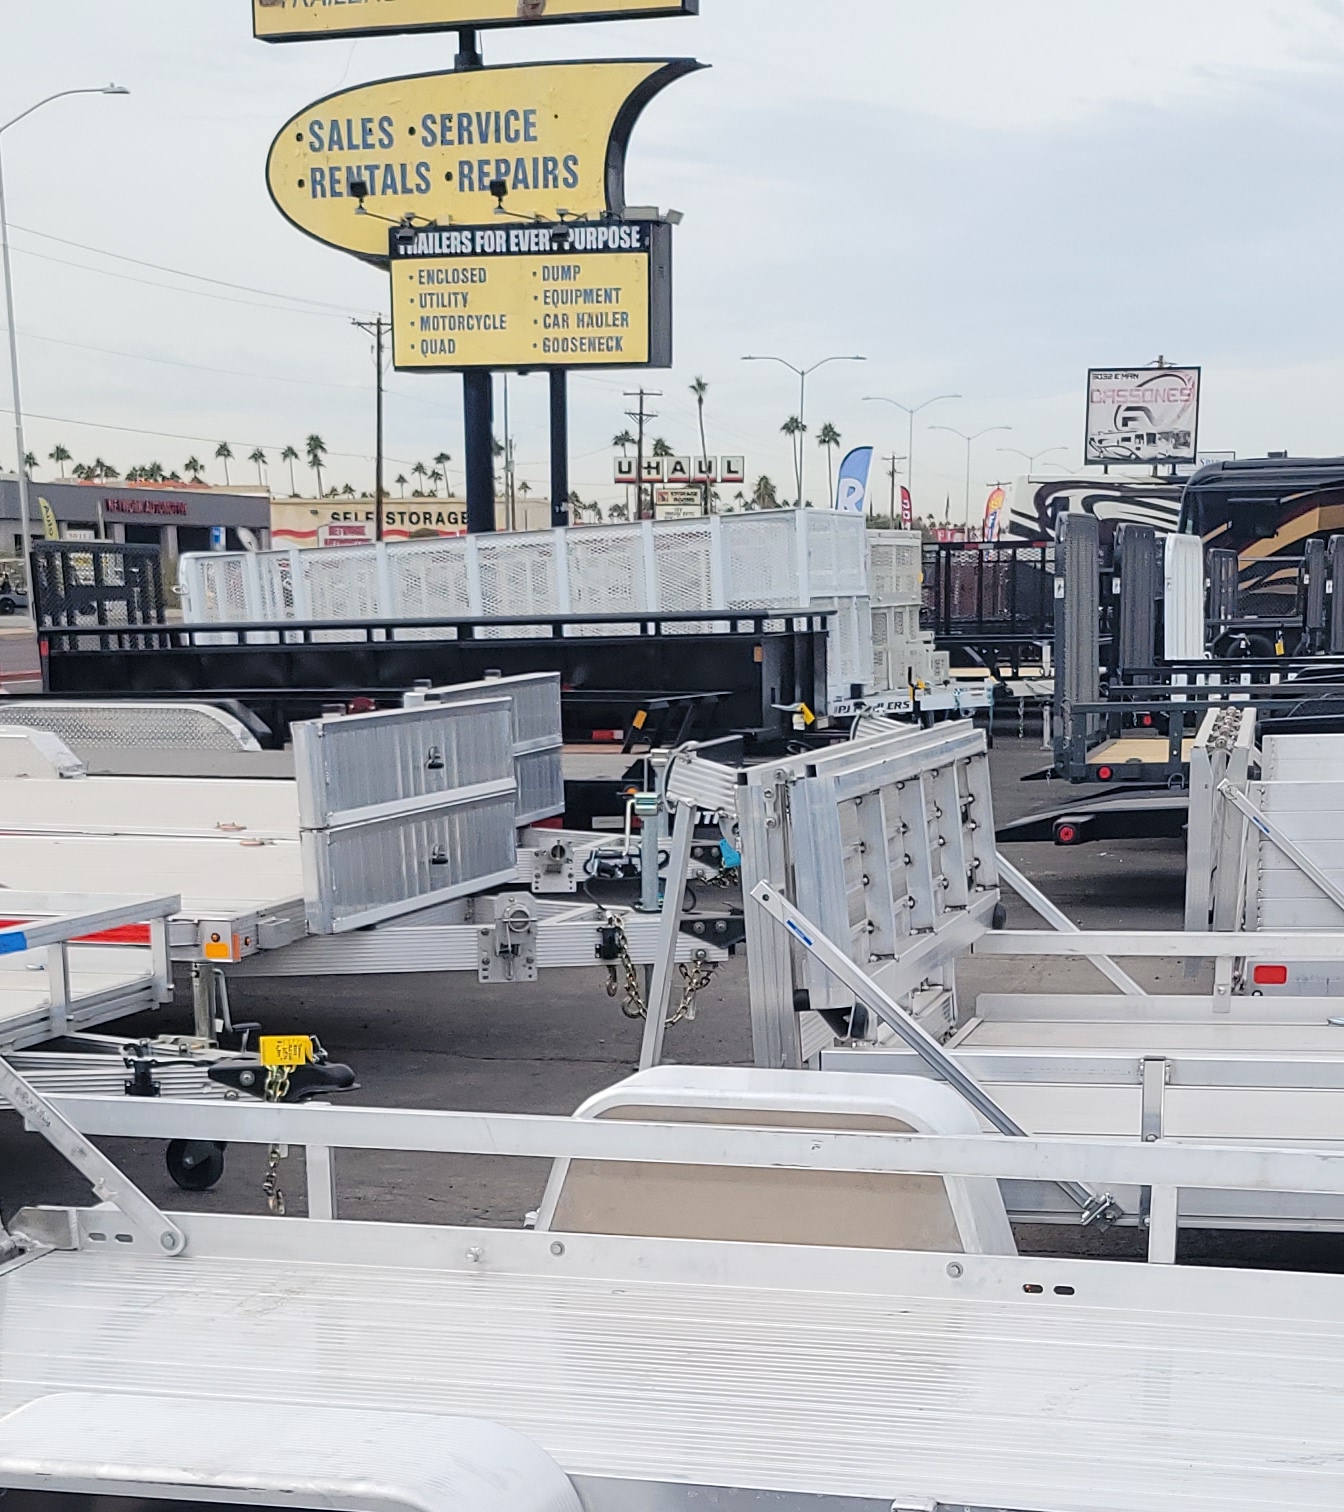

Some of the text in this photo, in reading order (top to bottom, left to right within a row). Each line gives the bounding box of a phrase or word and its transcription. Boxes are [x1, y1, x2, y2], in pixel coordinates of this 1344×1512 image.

[308, 109, 538, 153] SALES SERVICE
[310, 154, 579, 198] RENTALS REPAIRS
[475, 230, 506, 253] FOR
[418, 267, 487, 285] ENCLOSED
[542, 265, 581, 282] DUMP
[419, 292, 469, 309] UTILITY
[543, 288, 622, 307] EQUIPMENT
[420, 313, 507, 332] MOTORCYCLE
[543, 311, 630, 329] CAR HAULER
[420, 338, 457, 357] QUAD
[542, 336, 625, 354] GOOSENECK
